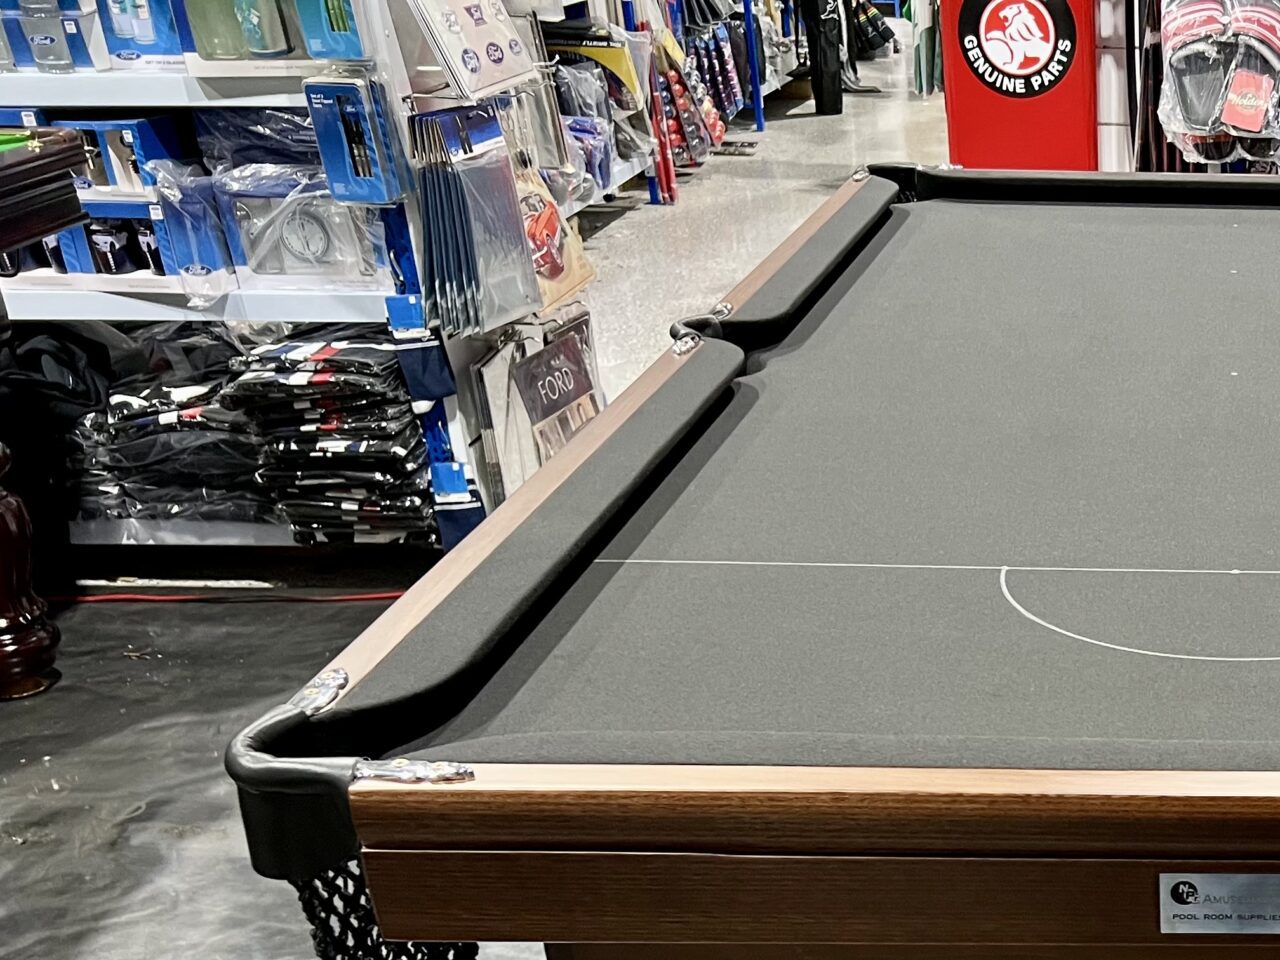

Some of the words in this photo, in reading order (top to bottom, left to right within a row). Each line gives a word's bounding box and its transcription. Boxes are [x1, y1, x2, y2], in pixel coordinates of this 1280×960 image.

[964, 35, 1026, 93] GENUINE
[1030, 39, 1072, 91] PARTS
[537, 367, 574, 405] FORD
[1172, 913, 1199, 921] POOL
[1203, 913, 1233, 921] ROOM
